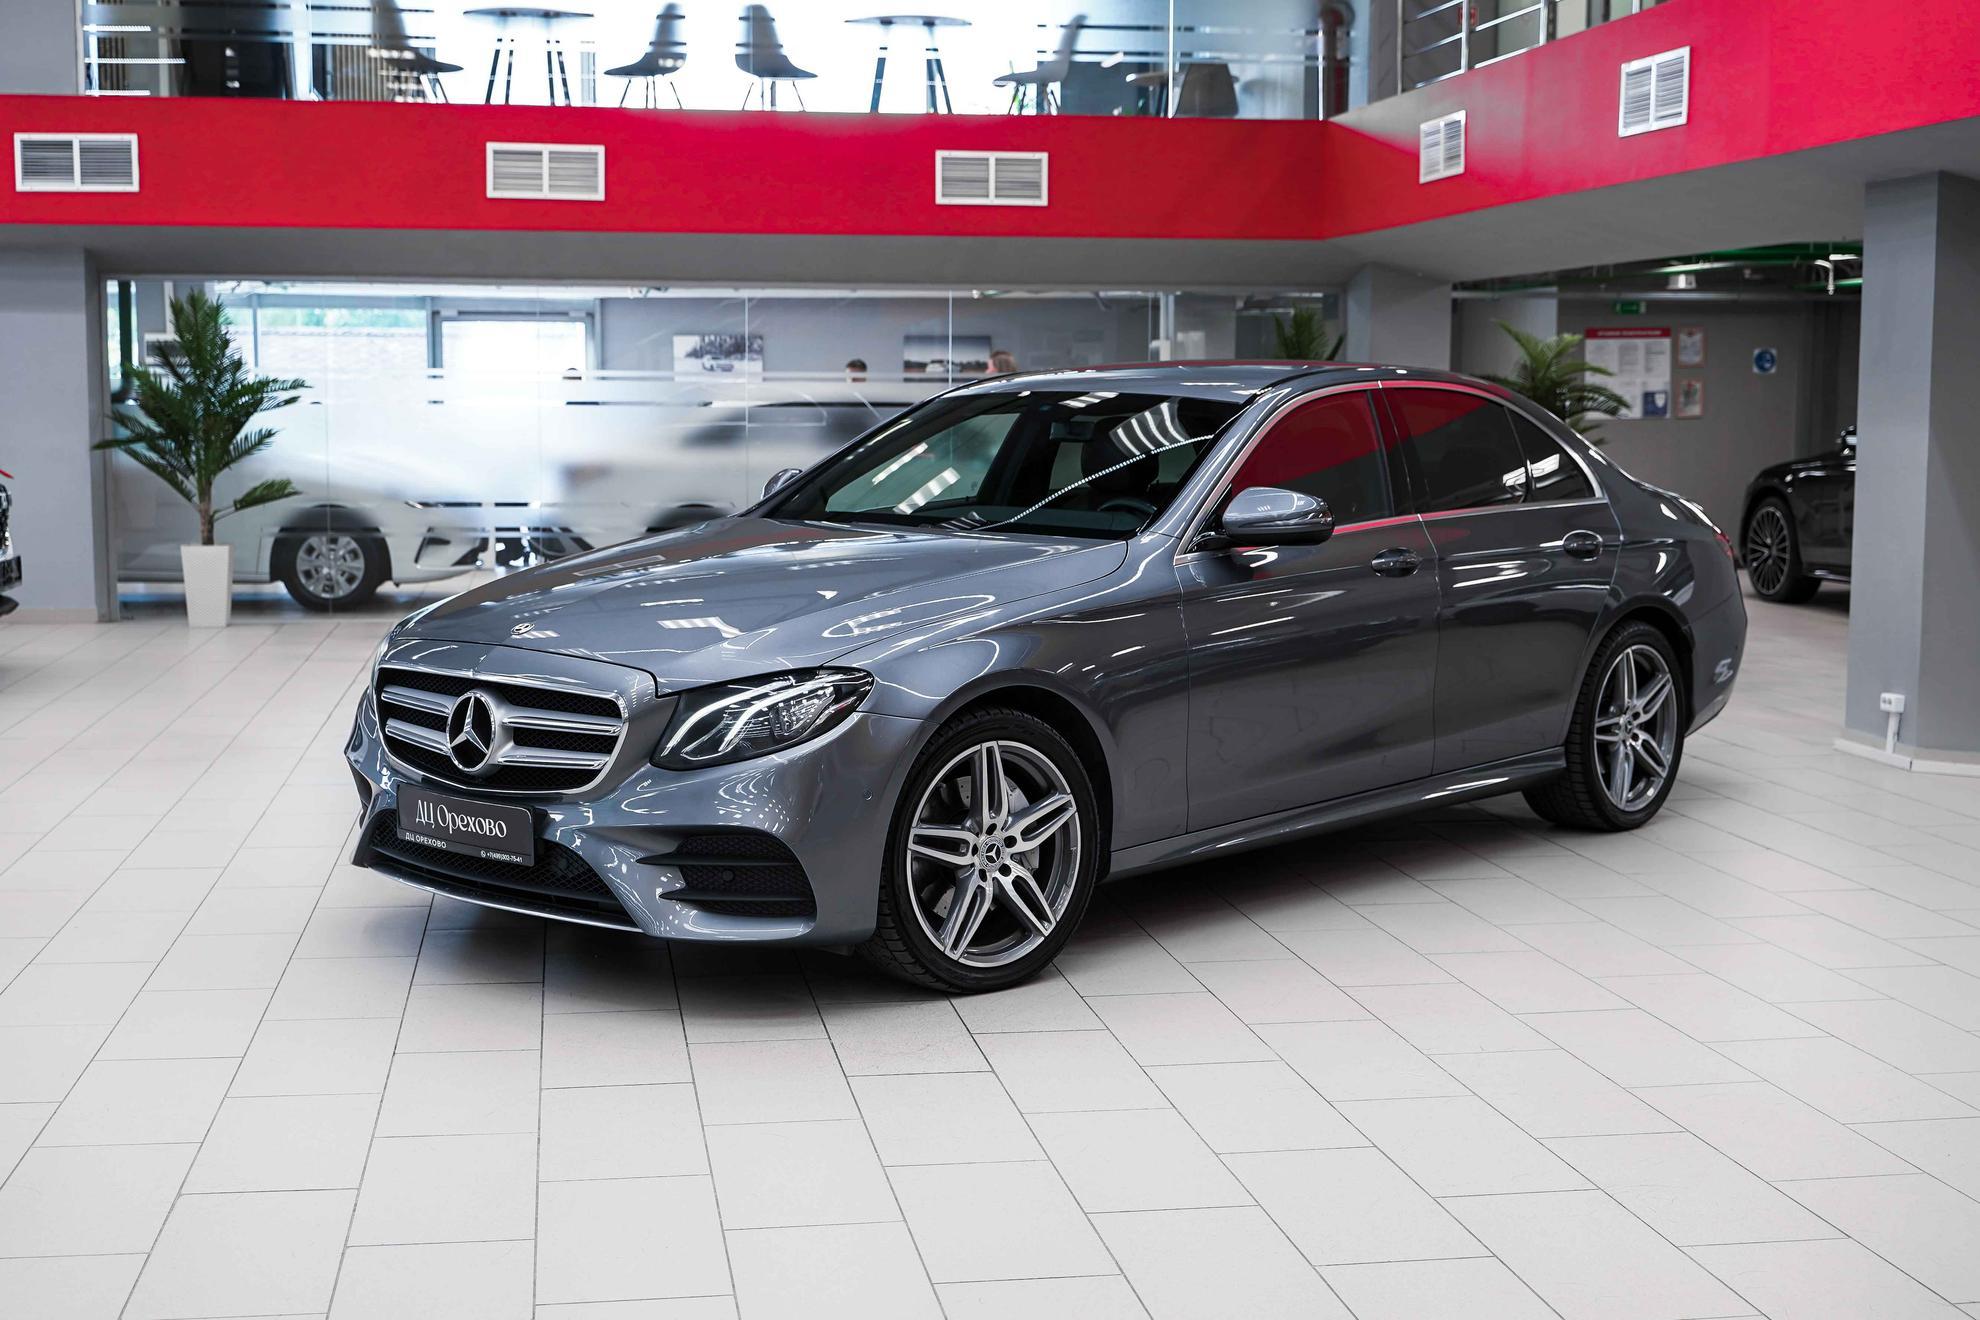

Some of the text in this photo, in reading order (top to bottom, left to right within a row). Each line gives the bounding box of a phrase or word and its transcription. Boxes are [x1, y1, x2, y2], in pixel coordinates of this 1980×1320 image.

[415, 799, 507, 838] ДЦ Орехово
[405, 832, 447, 849] ДЦ ОРЕХОВО
